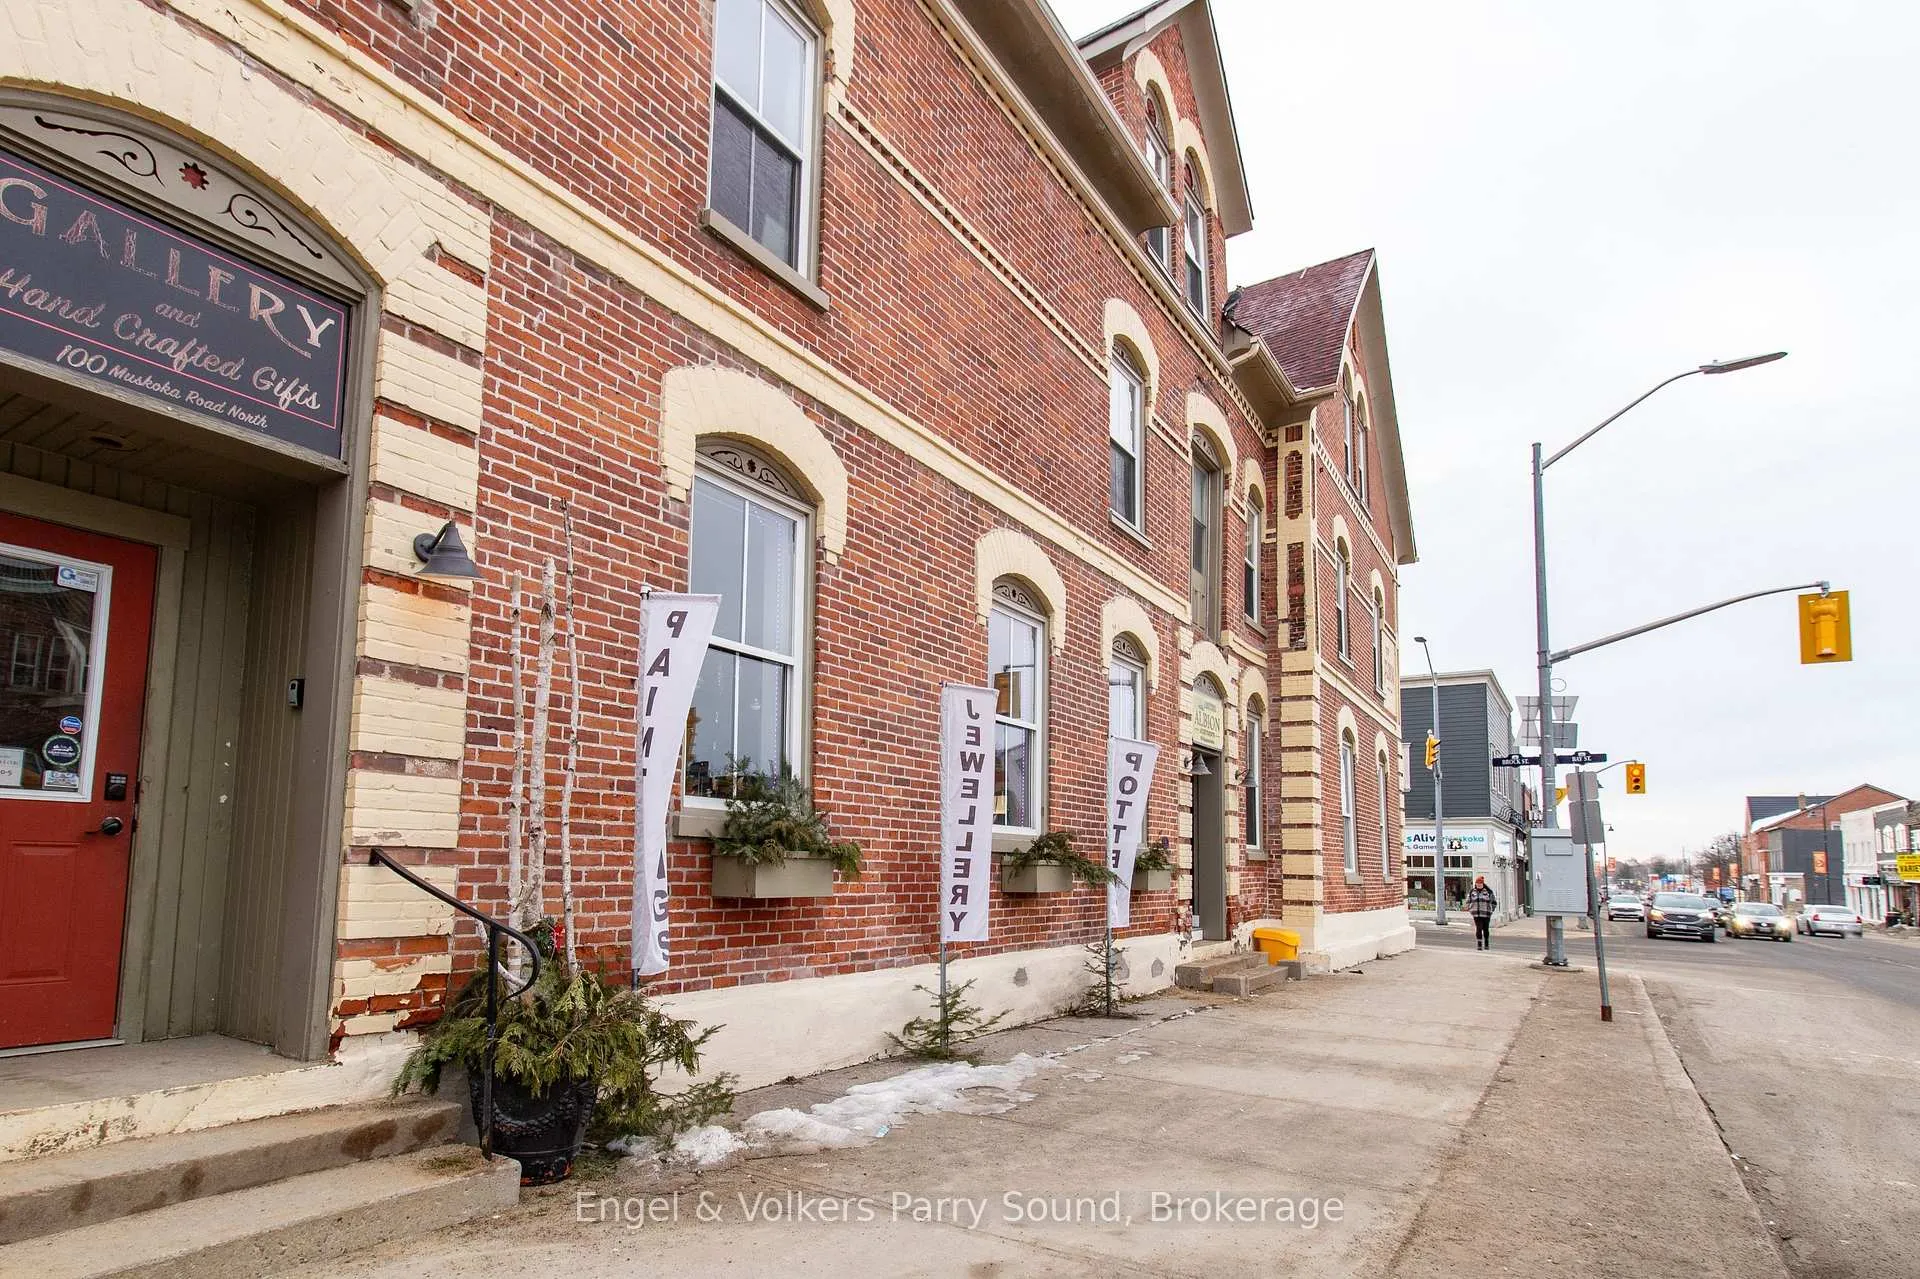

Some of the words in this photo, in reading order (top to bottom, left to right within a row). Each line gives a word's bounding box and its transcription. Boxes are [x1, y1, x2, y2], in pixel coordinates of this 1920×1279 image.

[0, 177, 335, 358] GALLERY
[155, 303, 200, 328] and
[0, 267, 106, 329] Hand
[113, 313, 247, 381] Crafted
[252, 366, 321, 411] Gifts
[56, 344, 108, 374] 100
[108, 364, 182, 399] Muskoka
[185, 390, 225, 414] Road
[227, 404, 269, 429] North
